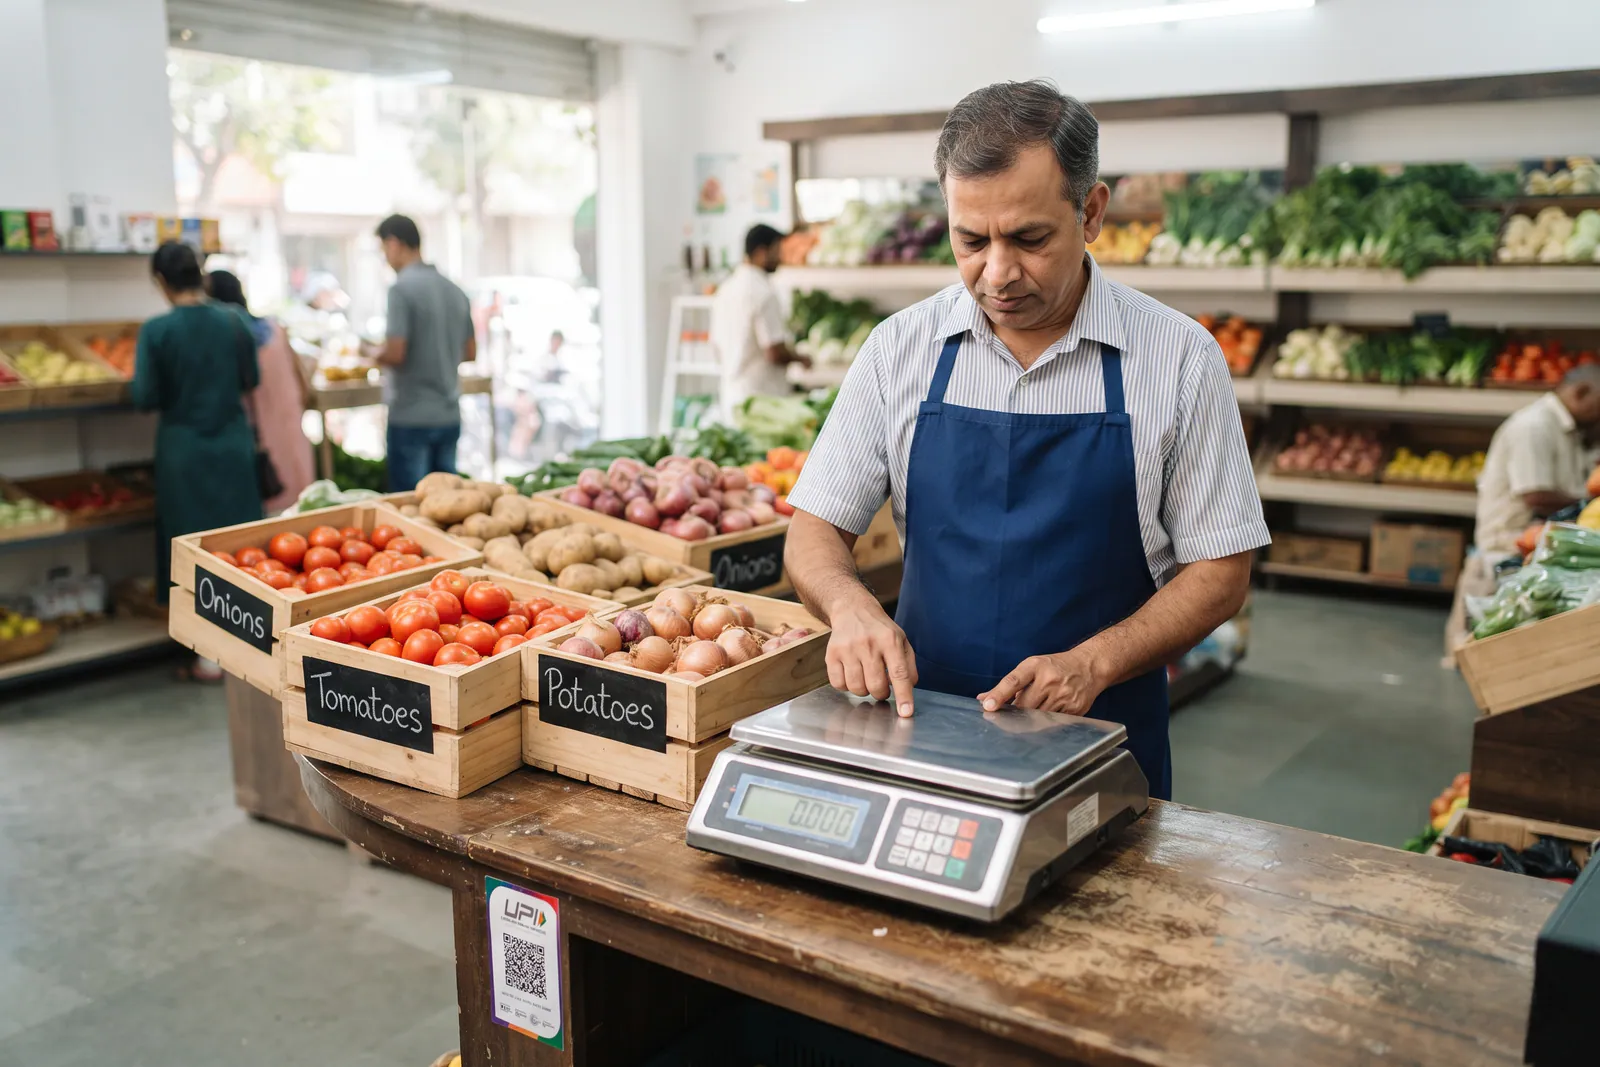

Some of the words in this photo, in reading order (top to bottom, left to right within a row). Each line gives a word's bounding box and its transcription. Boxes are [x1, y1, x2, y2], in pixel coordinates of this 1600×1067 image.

[199, 577, 265, 639] Onions
[310, 671, 423, 734] Tomatoes
[544, 667, 654, 730] Potatoes
[789, 799, 855, 837] 0.000
[504, 899, 539, 926] UPI
